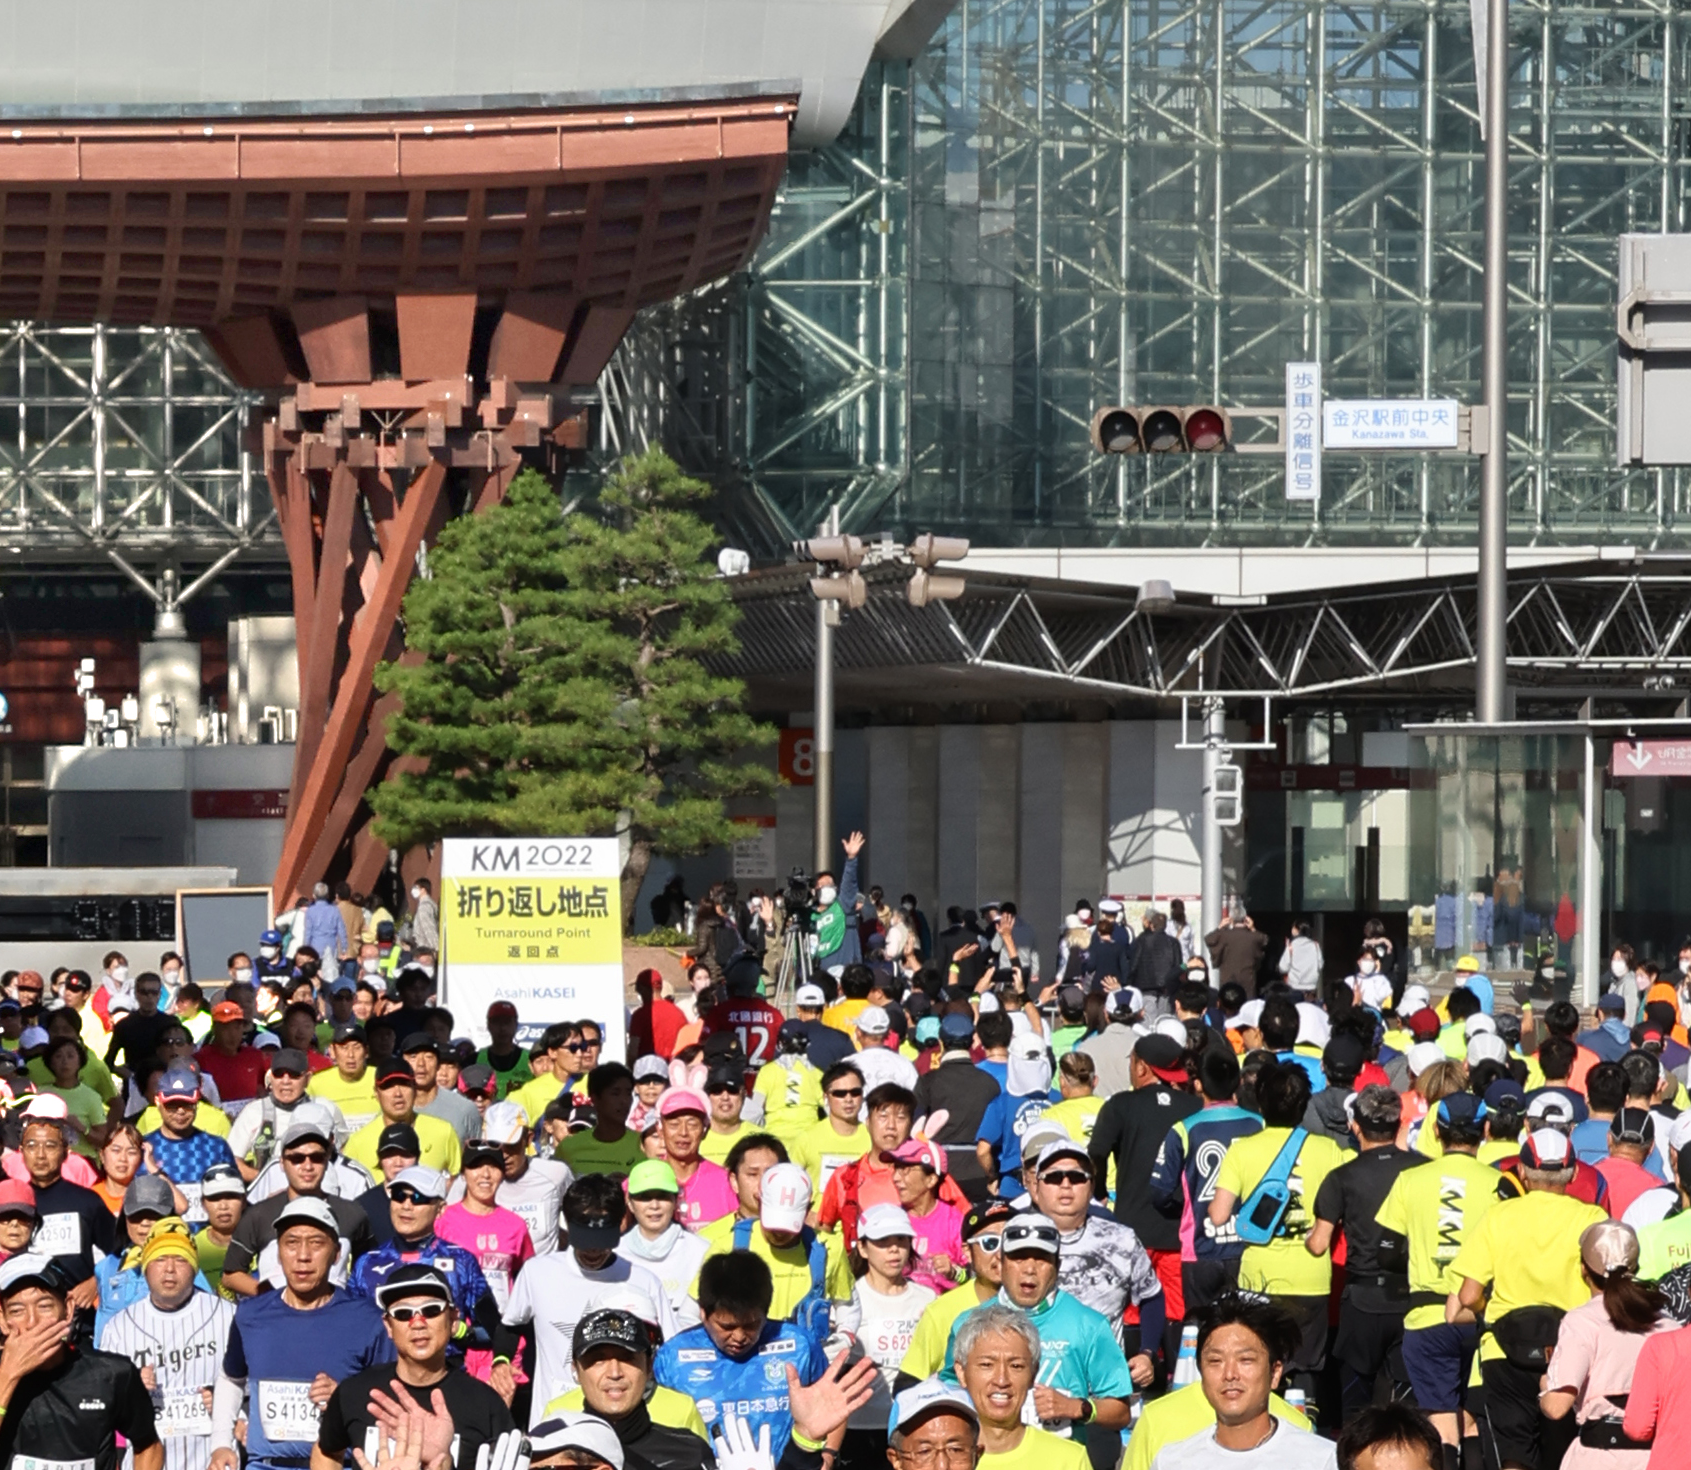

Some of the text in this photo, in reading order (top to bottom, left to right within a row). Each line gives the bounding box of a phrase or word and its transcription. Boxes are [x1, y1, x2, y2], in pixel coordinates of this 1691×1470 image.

[1332, 409, 1449, 427] 金沢駅前中央
[1293, 373, 1314, 490] 歩車分離信号
[1352, 430, 1405, 439] Kanazawa
[471, 845, 593, 871] KM 2022
[458, 885, 609, 918] 折り返し地点
[475, 927, 591, 939] Turnaround Point
[736, 1028, 769, 1065] 12
[780, 1188, 795, 1206] H
[134, 1341, 217, 1372] Tigers
